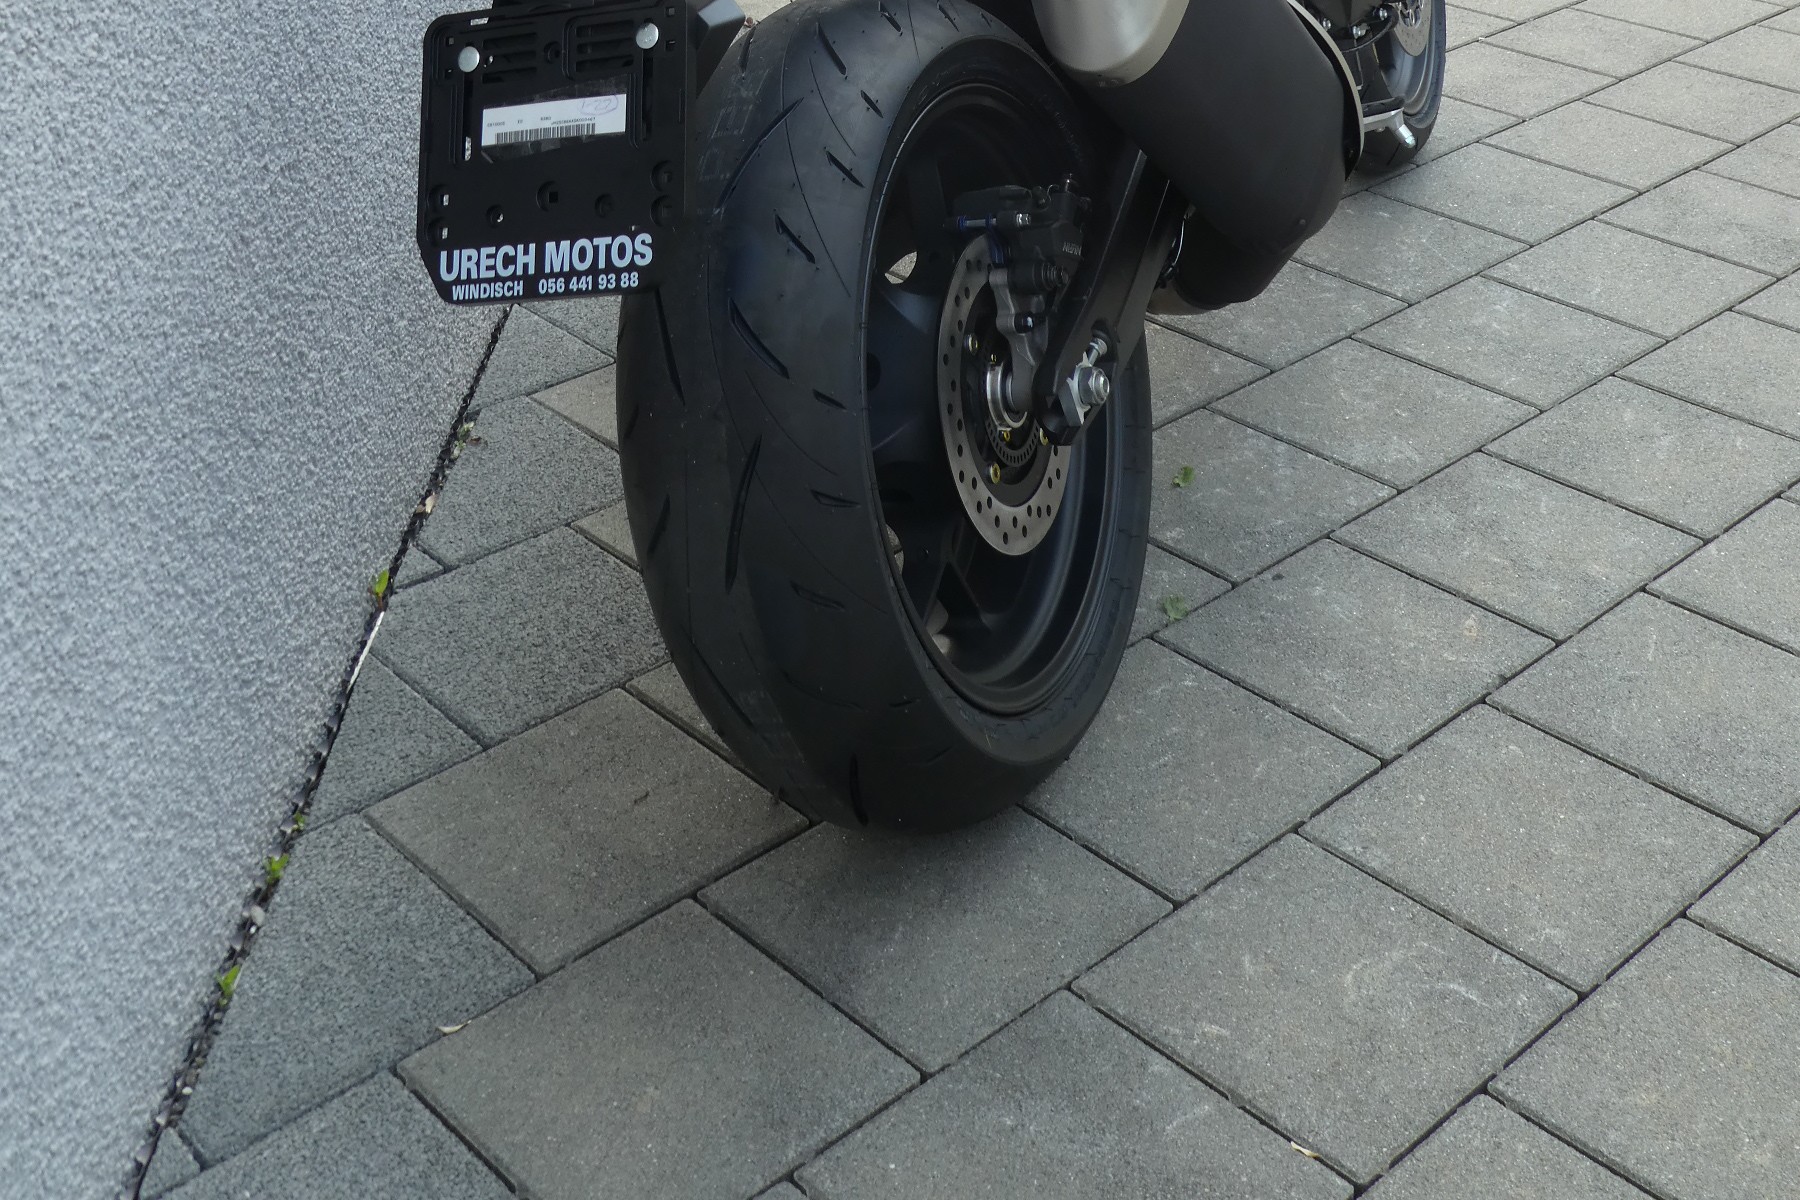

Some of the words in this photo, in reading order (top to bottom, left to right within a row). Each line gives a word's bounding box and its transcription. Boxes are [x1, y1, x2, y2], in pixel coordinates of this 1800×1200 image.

[440, 243, 536, 282] URECH
[544, 233, 653, 272] MOTOS
[452, 280, 524, 301] WINDISCH
[538, 278, 566, 295] 056
[569, 275, 593, 292] 441
[598, 273, 616, 290] 93
[620, 271, 639, 288] 88
